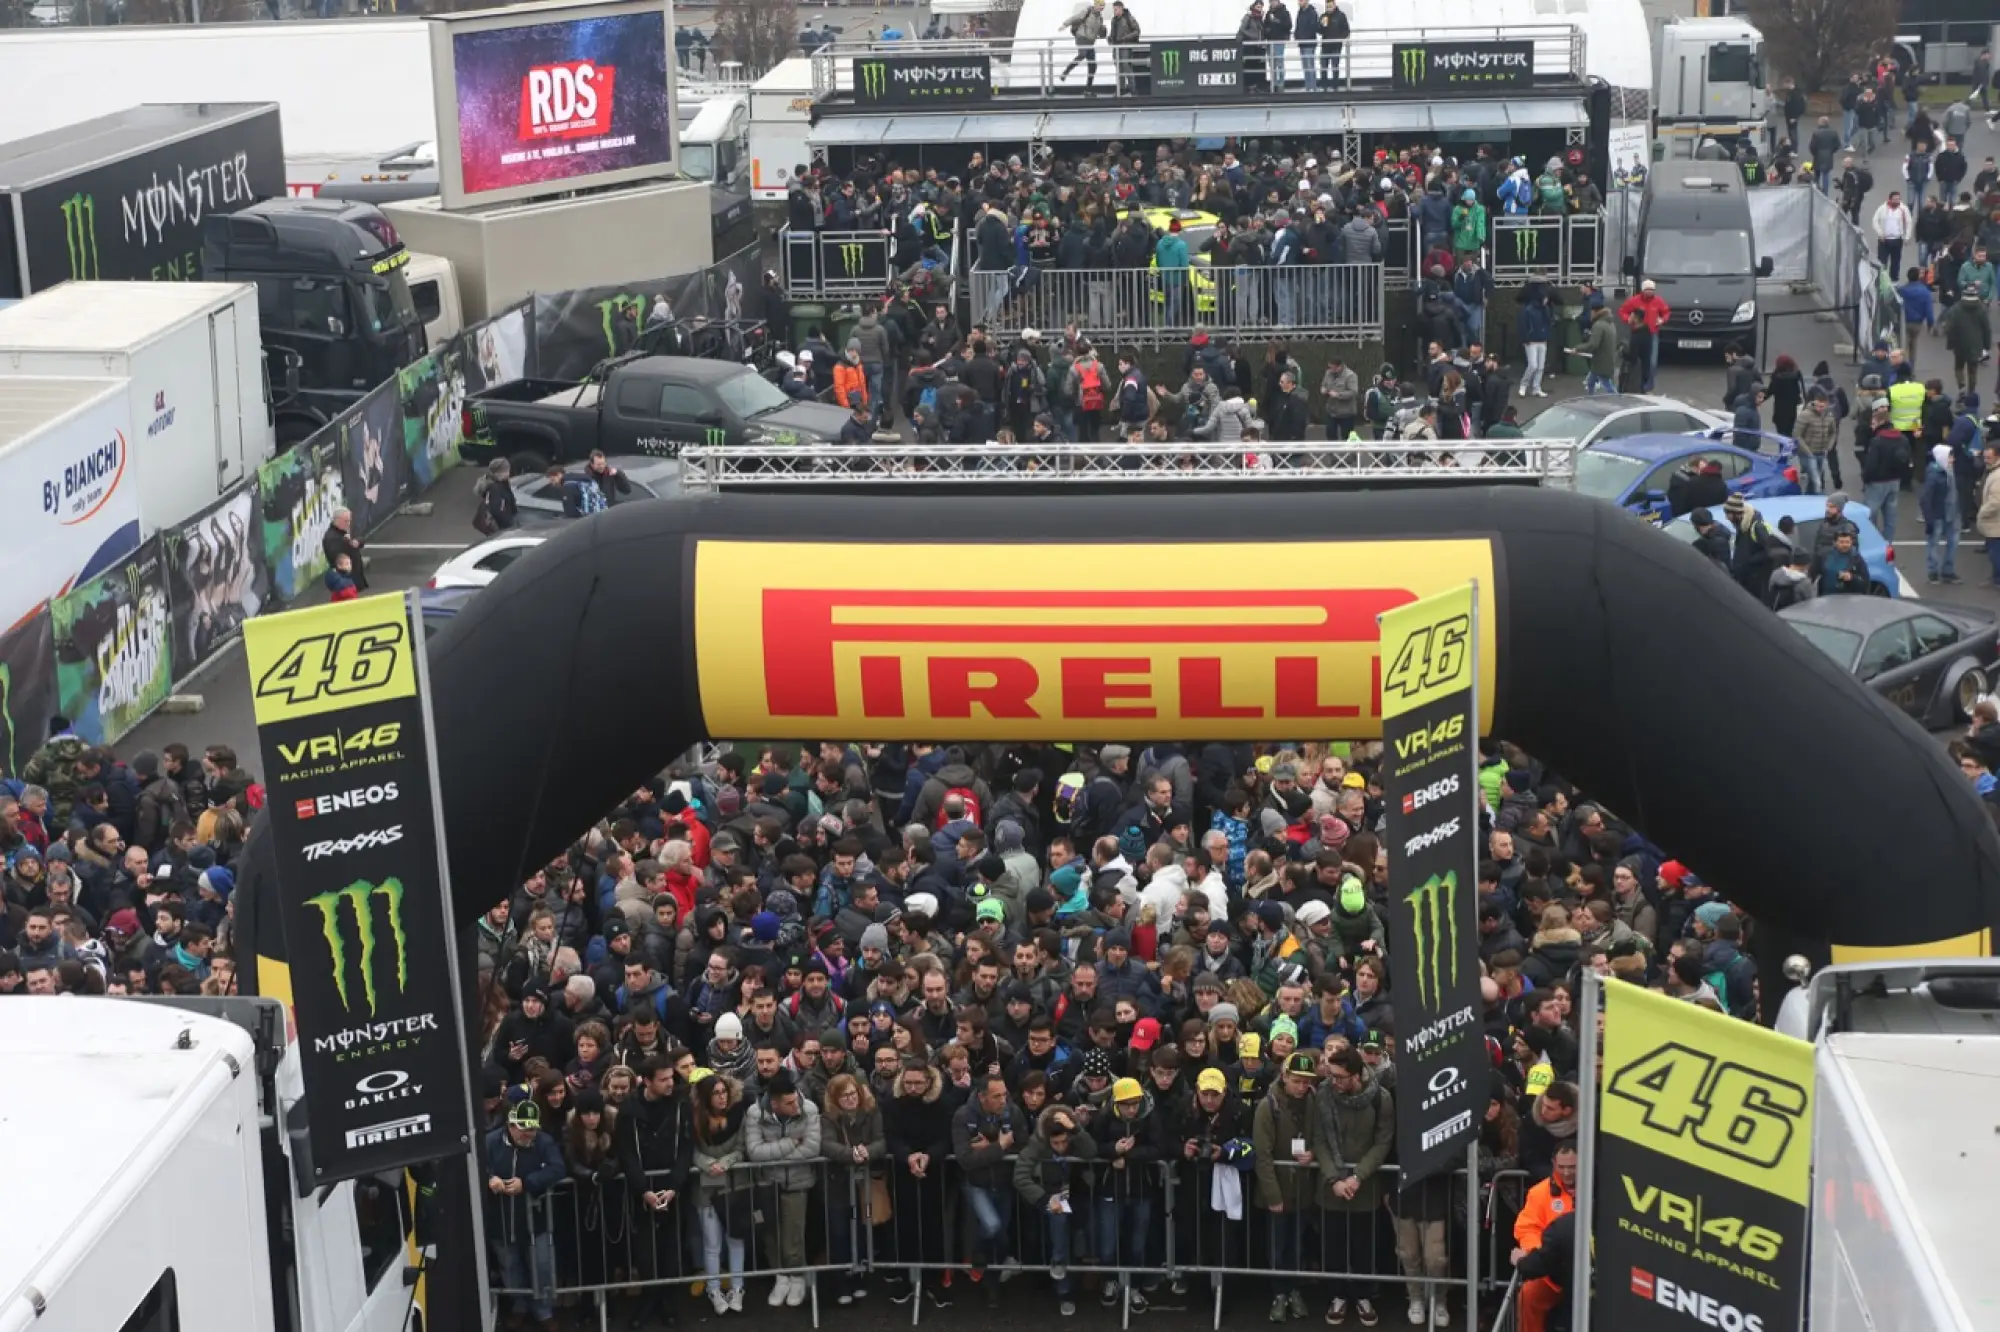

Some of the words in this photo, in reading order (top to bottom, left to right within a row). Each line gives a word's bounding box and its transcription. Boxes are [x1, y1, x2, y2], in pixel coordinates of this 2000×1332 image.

[893, 65, 985, 84] MONSTER
[1433, 51, 1528, 69] MONSTER
[1450, 73, 1516, 81] ENERGY
[529, 64, 598, 126] RDS
[910, 87, 975, 96] ENERGY
[121, 150, 254, 247] MONSTER
[43, 480, 61, 515] By
[64, 438, 117, 499] BIANCHI
[256, 621, 404, 704] 46
[1384, 614, 1469, 699] 46
[280, 764, 335, 783] RACING
[340, 750, 405, 771] APPAREL
[1427, 743, 1465, 768] APPAREL
[316, 781, 400, 815] ENEOS
[1413, 773, 1460, 810] ENEOS
[302, 824, 404, 861] TRAXXAS
[314, 1012, 439, 1055] MONSTER
[1405, 1005, 1475, 1054] MONSTER
[1417, 1031, 1466, 1062] ENERGY
[336, 1036, 423, 1063] ENERGY
[344, 1083, 425, 1111] OAKLEY
[1422, 1079, 1468, 1111] OAKLEY
[1606, 1040, 1809, 1169] 46
[345, 1114, 432, 1150] PIRELLI
[1421, 1108, 1473, 1152] PIRELLI
[1618, 1216, 1687, 1254] RACING
[1692, 1248, 1782, 1291] APPAREL
[1655, 1277, 1764, 1332] ENEOS
